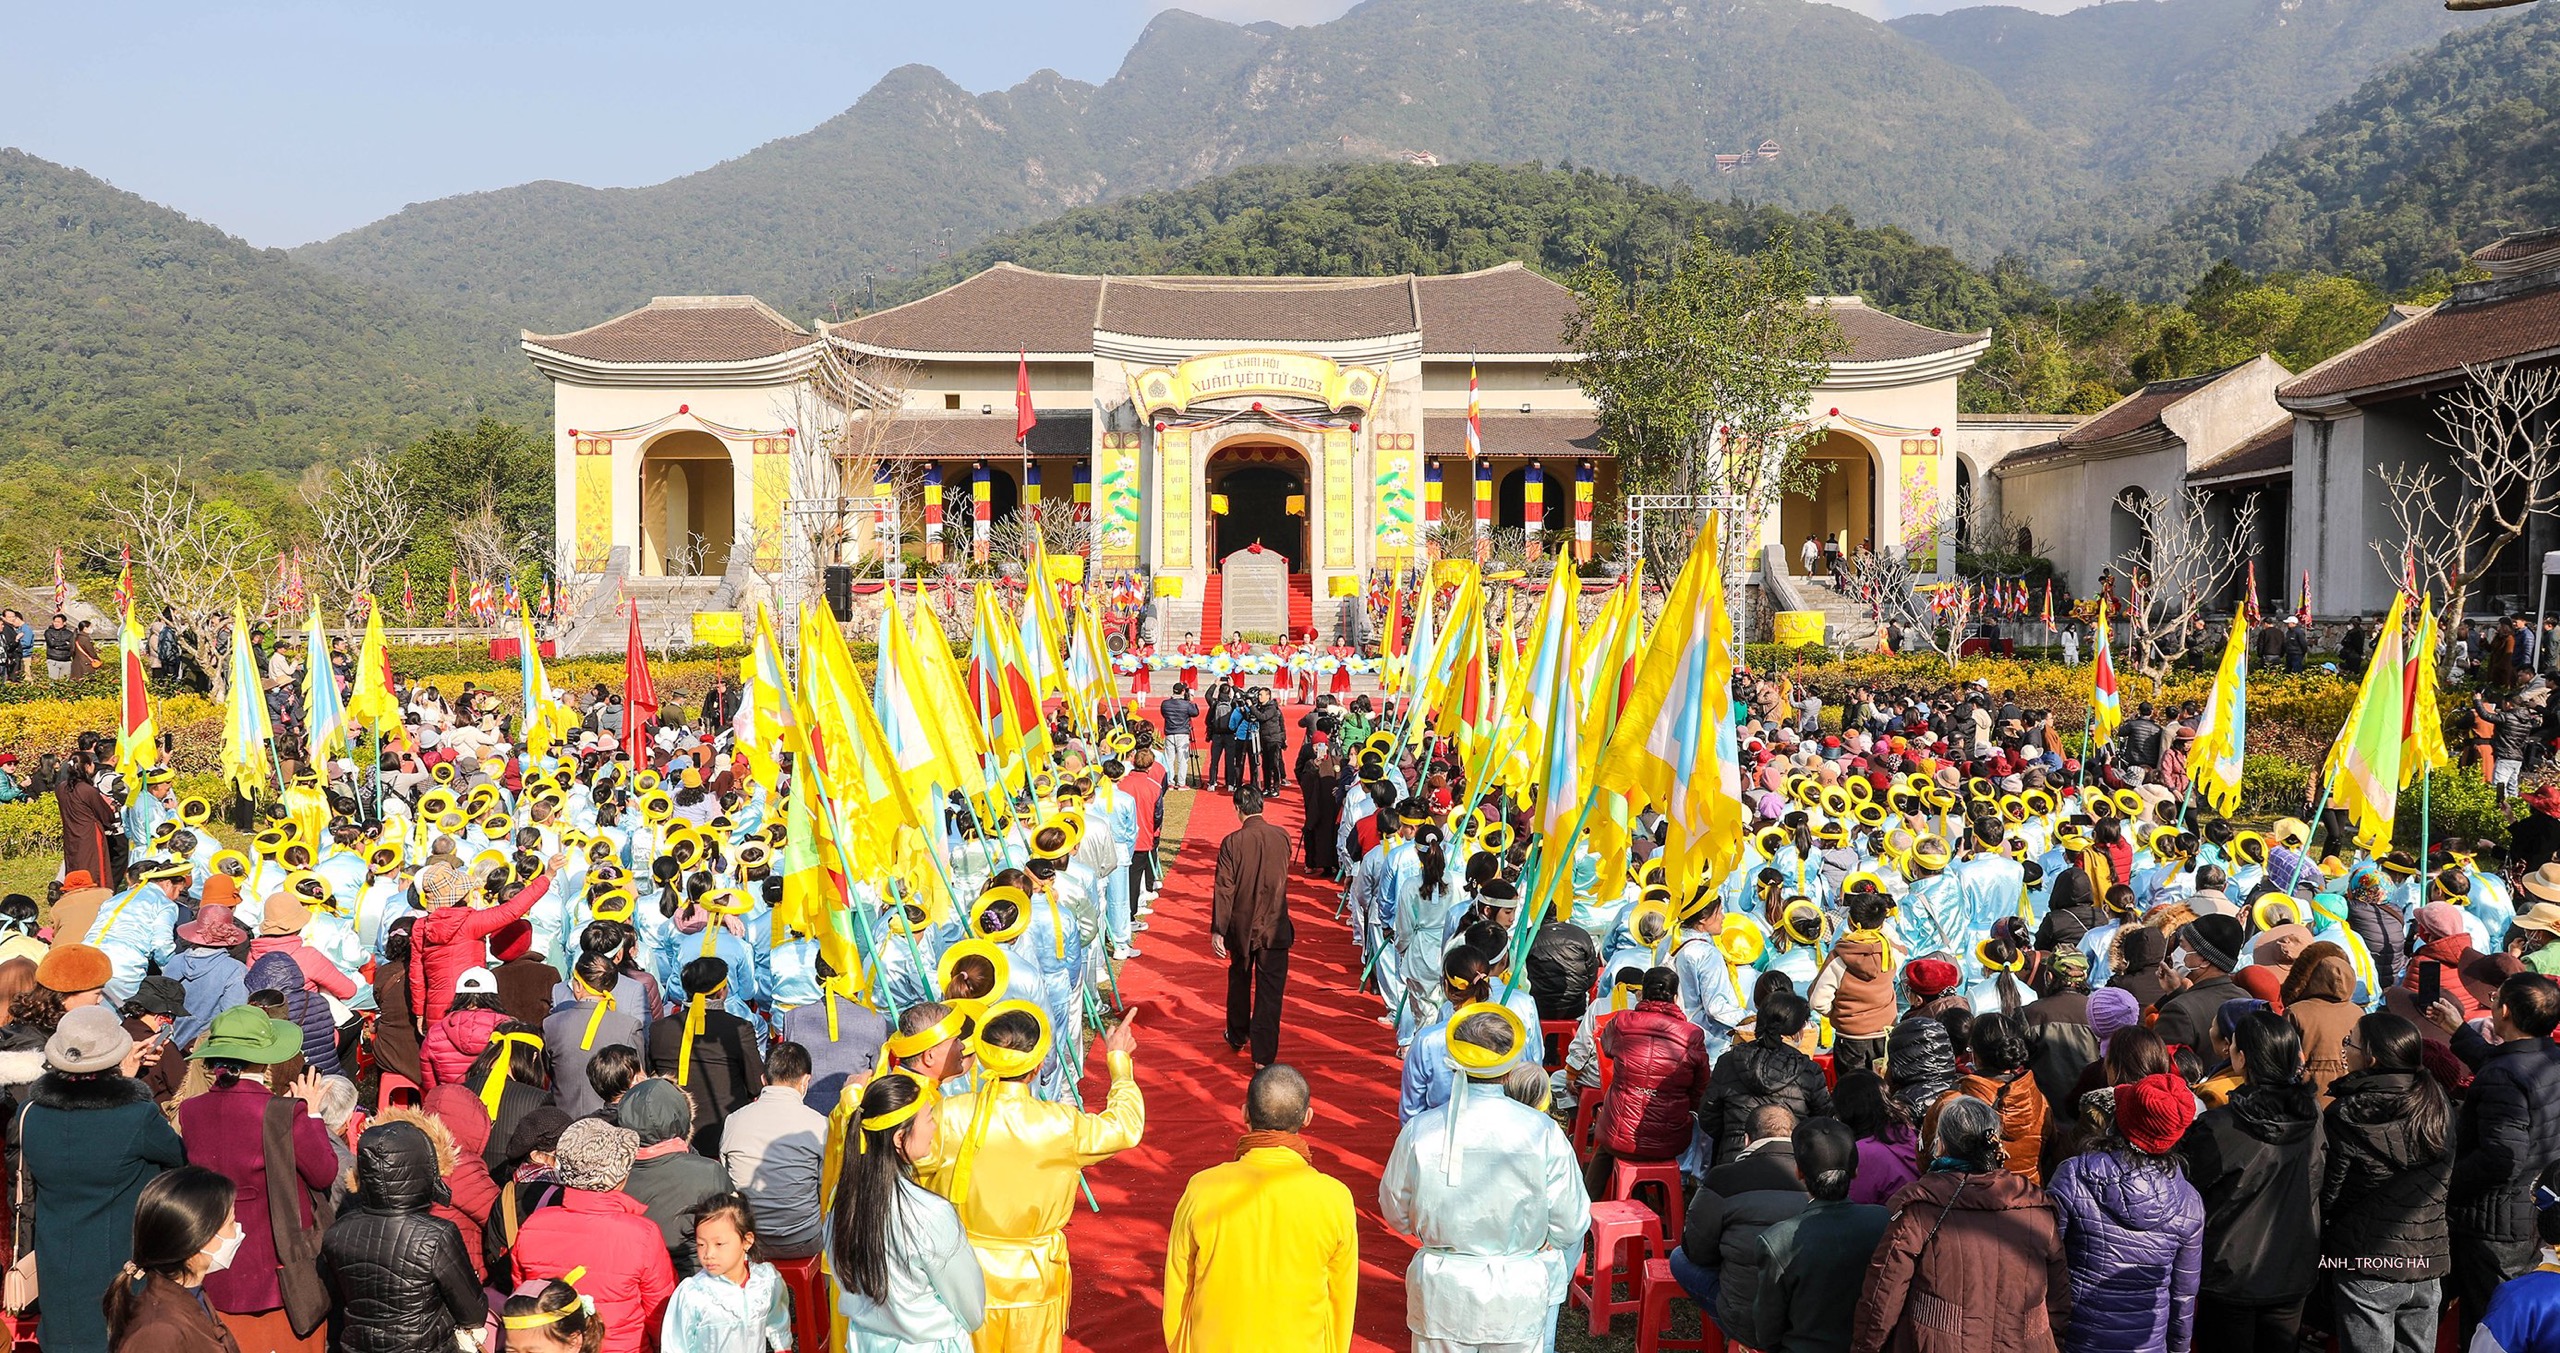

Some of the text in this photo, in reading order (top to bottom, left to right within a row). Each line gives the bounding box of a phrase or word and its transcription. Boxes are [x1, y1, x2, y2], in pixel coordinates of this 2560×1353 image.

[1237, 357, 1260, 368] KHAI
[1191, 374, 1232, 393] XUÂN
[1235, 370, 1264, 388] YÊN
[1290, 375, 1322, 392] 2023
